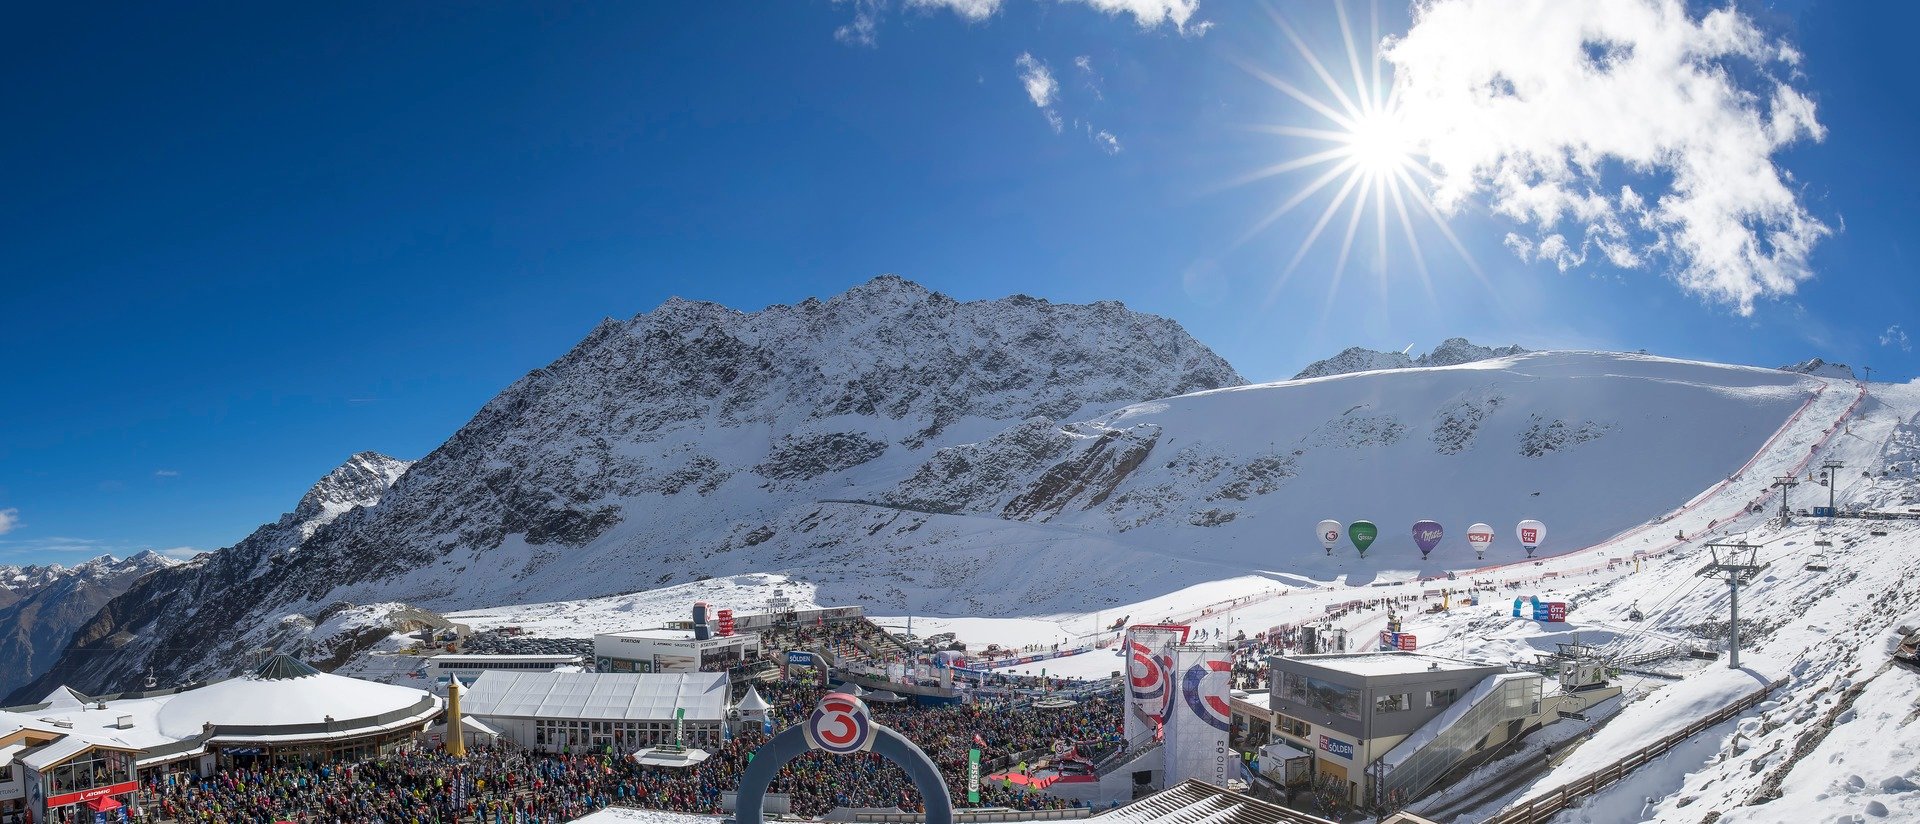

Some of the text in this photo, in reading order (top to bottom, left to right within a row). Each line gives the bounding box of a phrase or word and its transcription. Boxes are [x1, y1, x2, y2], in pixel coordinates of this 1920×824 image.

[1550, 604, 1564, 613] ÖTZ
[1329, 743, 1353, 755] SÖLDEN
[1215, 740, 1224, 786] RADIO Ö3
[86, 788, 111, 798] ATOMIC
